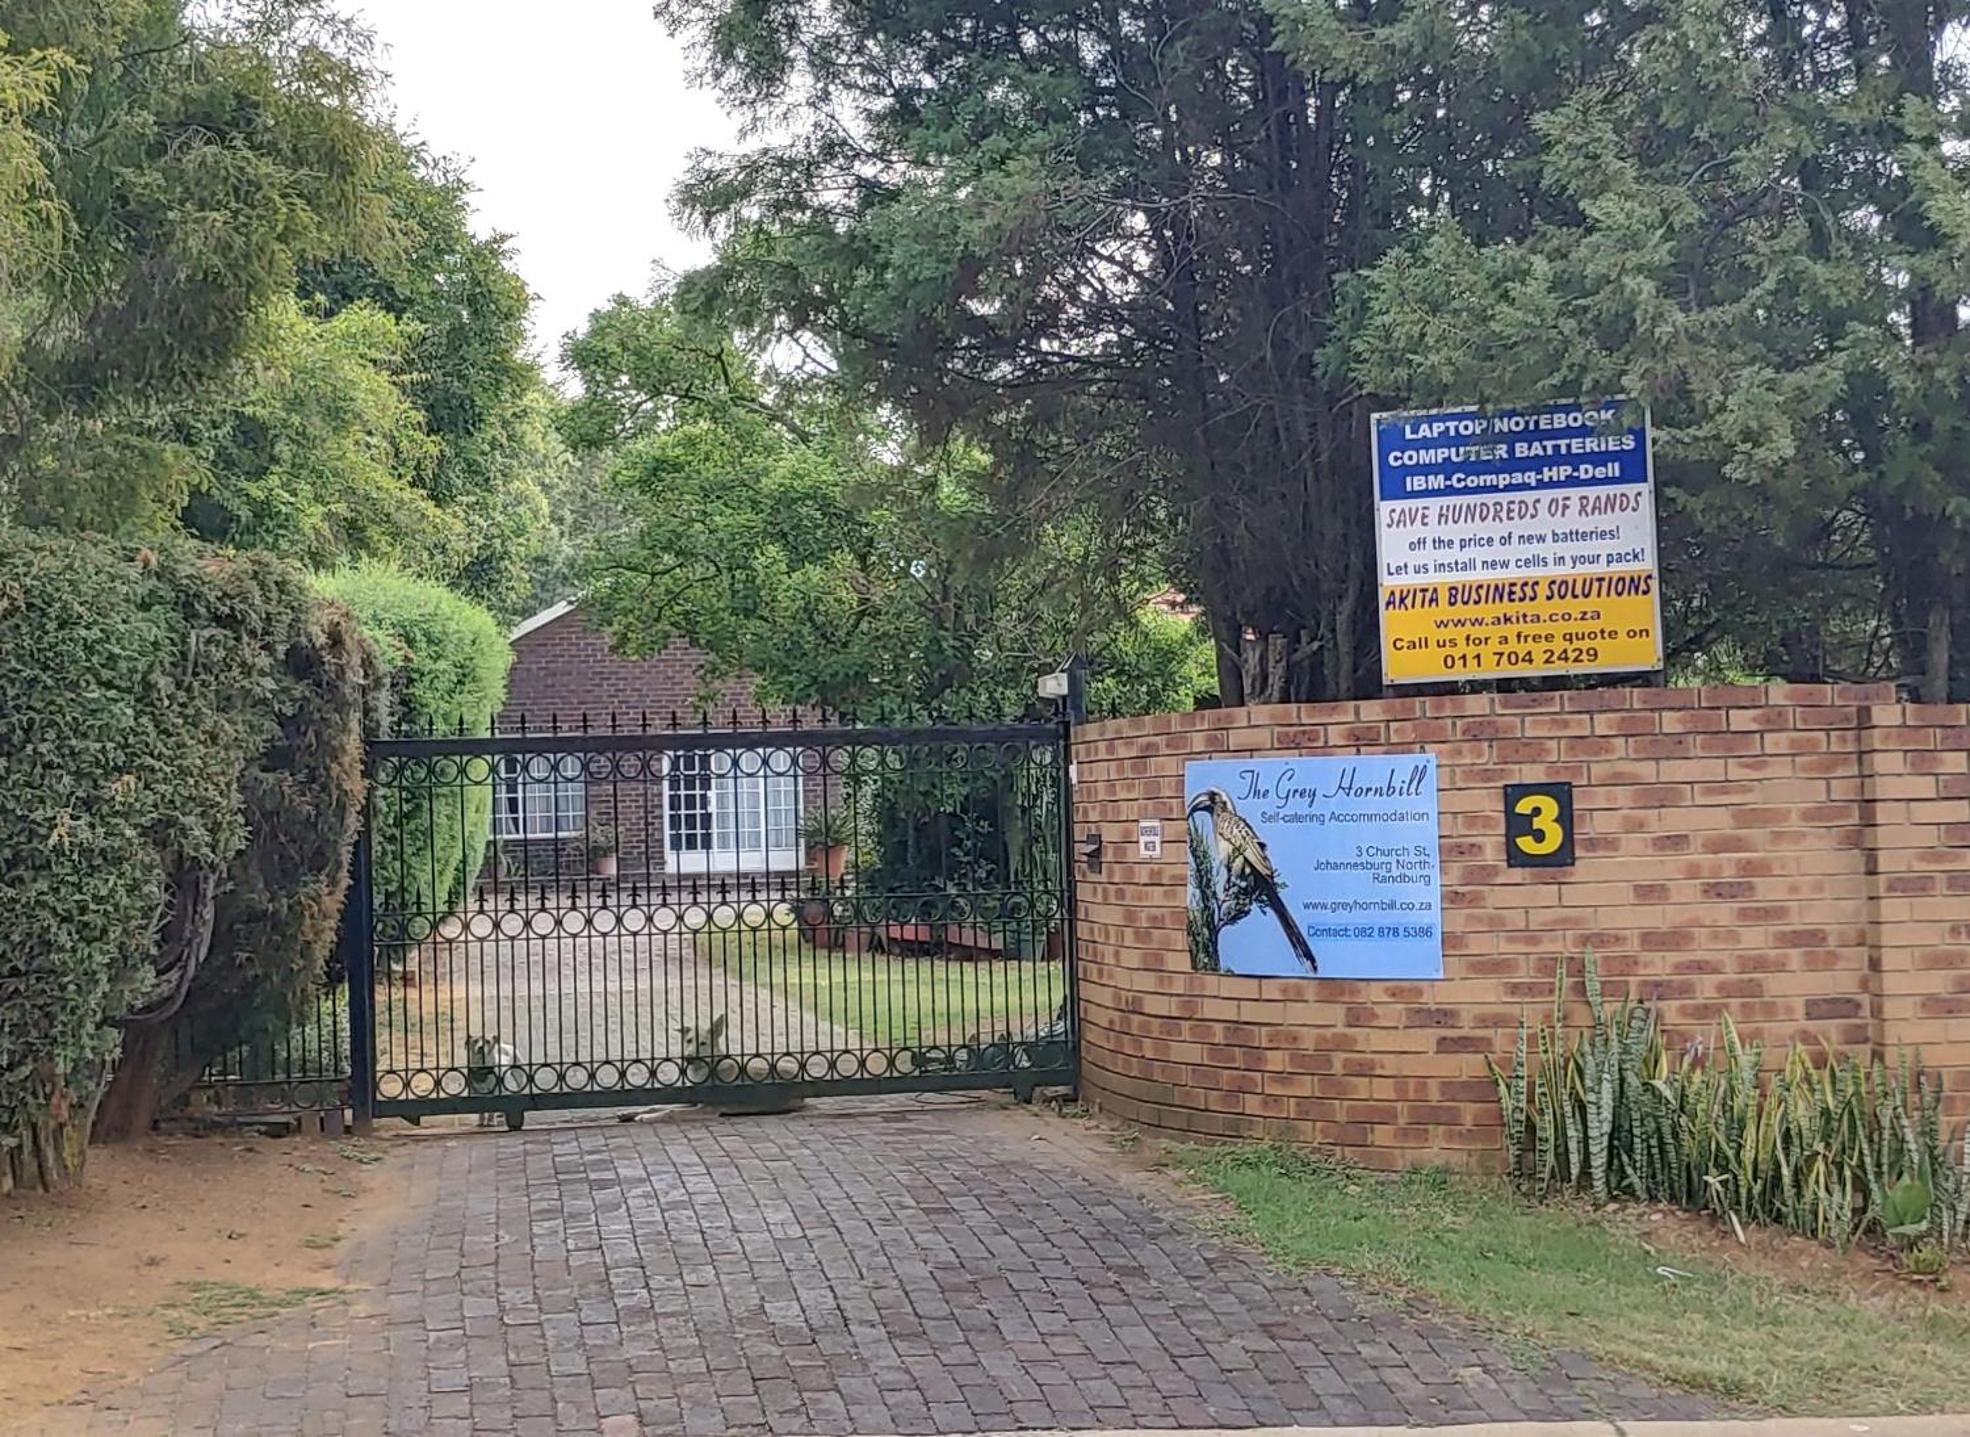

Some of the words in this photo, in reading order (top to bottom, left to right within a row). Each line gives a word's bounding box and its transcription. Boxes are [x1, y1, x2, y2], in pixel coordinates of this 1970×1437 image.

[1387, 443, 1509, 467] COMPUTER
[1514, 434, 1636, 459] BATTERIES
[1405, 462, 1621, 492] IBM-Compaq-HP-Dell
[1386, 506, 1430, 529] SAVE
[1437, 498, 1541, 526] HUNDREDS
[1547, 496, 1572, 518] OF
[1578, 491, 1643, 517] RANDS
[1408, 536, 1428, 552] off
[1432, 536, 1455, 550] the
[1459, 533, 1494, 552] price
[1498, 531, 1513, 546] of
[1517, 533, 1547, 546] new
[1551, 525, 1621, 544] batteries!
[1386, 562, 1409, 576] Let
[1413, 562, 1430, 575] us
[1433, 557, 1477, 574] install
[1481, 558, 1510, 571] new
[1514, 553, 1549, 569] cells
[1552, 552, 1566, 567] in
[1570, 552, 1602, 569] your
[1605, 547, 1645, 567] pack!
[1384, 586, 1440, 612] AKITA
[1447, 580, 1540, 608] BUSINESS
[1545, 573, 1653, 601] SOLUTIONS
[1434, 609, 1602, 630] www.akita.co.za
[1392, 636, 1429, 651] Call
[1436, 637, 1458, 649] us
[1464, 634, 1491, 647] for
[1497, 635, 1509, 646] a
[1515, 631, 1556, 645] free
[1562, 627, 1619, 645] quote
[1626, 628, 1650, 639] on
[1443, 652, 1482, 670] 011
[1492, 649, 1535, 668] 704
[1542, 646, 1599, 666] 2429
[1237, 769, 1270, 801] The
[1274, 767, 1317, 809] Grey
[1322, 763, 1428, 799] Hornbill
[1260, 811, 1326, 826] Self-catering
[1328, 810, 1430, 824] Accommodation
[1514, 794, 1564, 855] 3
[1355, 846, 1363, 858] 3
[1366, 845, 1410, 857] Church
[1313, 859, 1393, 873] Johannesburg
[1371, 873, 1431, 886] Randburg
[1302, 899, 1433, 913] www.greyhornbill.co.za
[1307, 925, 1351, 938] Contact:
[1353, 926, 1375, 938] 082
[1377, 926, 1400, 938] 878
[1403, 925, 1433, 938] 5386
